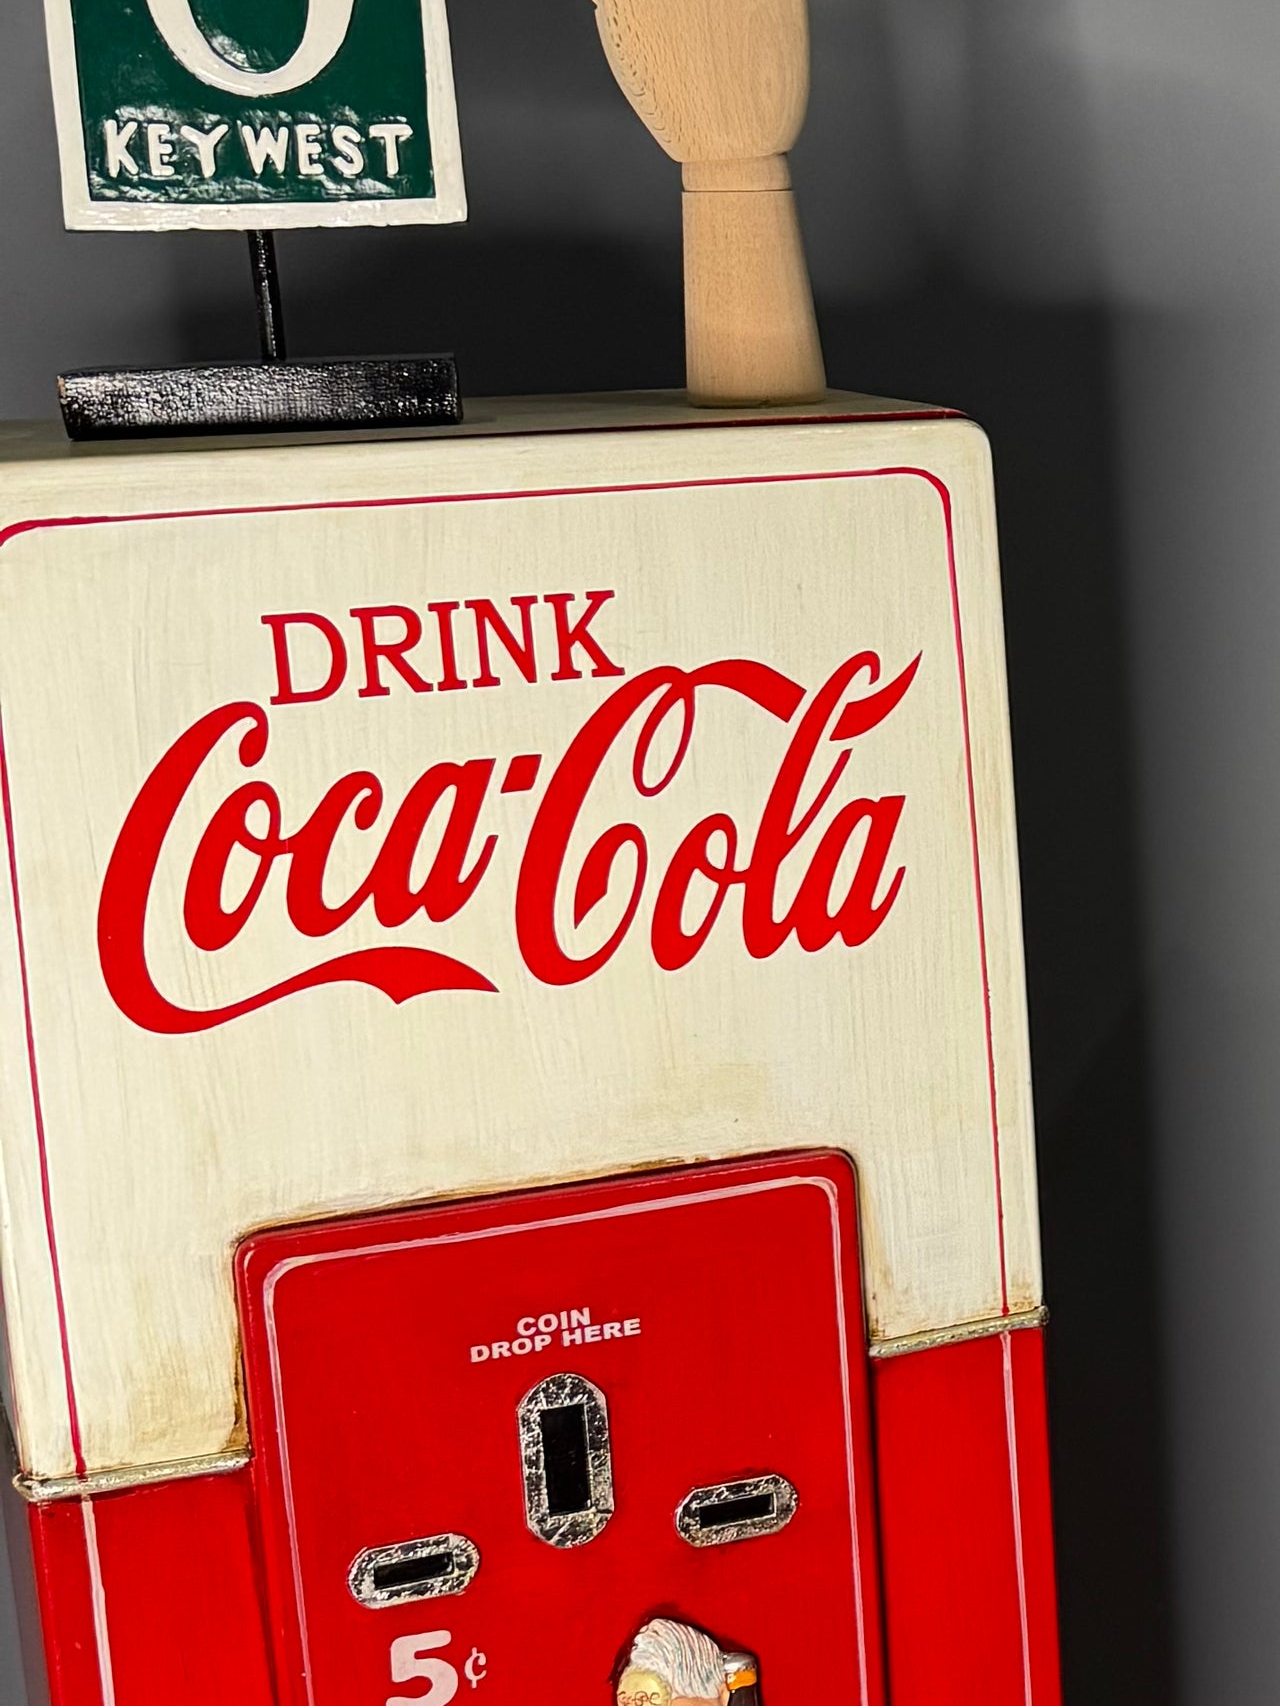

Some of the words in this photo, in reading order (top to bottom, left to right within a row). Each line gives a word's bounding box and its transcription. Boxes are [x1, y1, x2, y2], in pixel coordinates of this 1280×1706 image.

[103, 119, 228, 180] KEY
[237, 117, 414, 179] WEST
[260, 589, 625, 706] DRINK
[97, 650, 922, 1035] Coca-Cola
[470, 1334, 553, 1363] DROP
[562, 1318, 641, 1347] HERE
[517, 1307, 591, 1336] COIN
